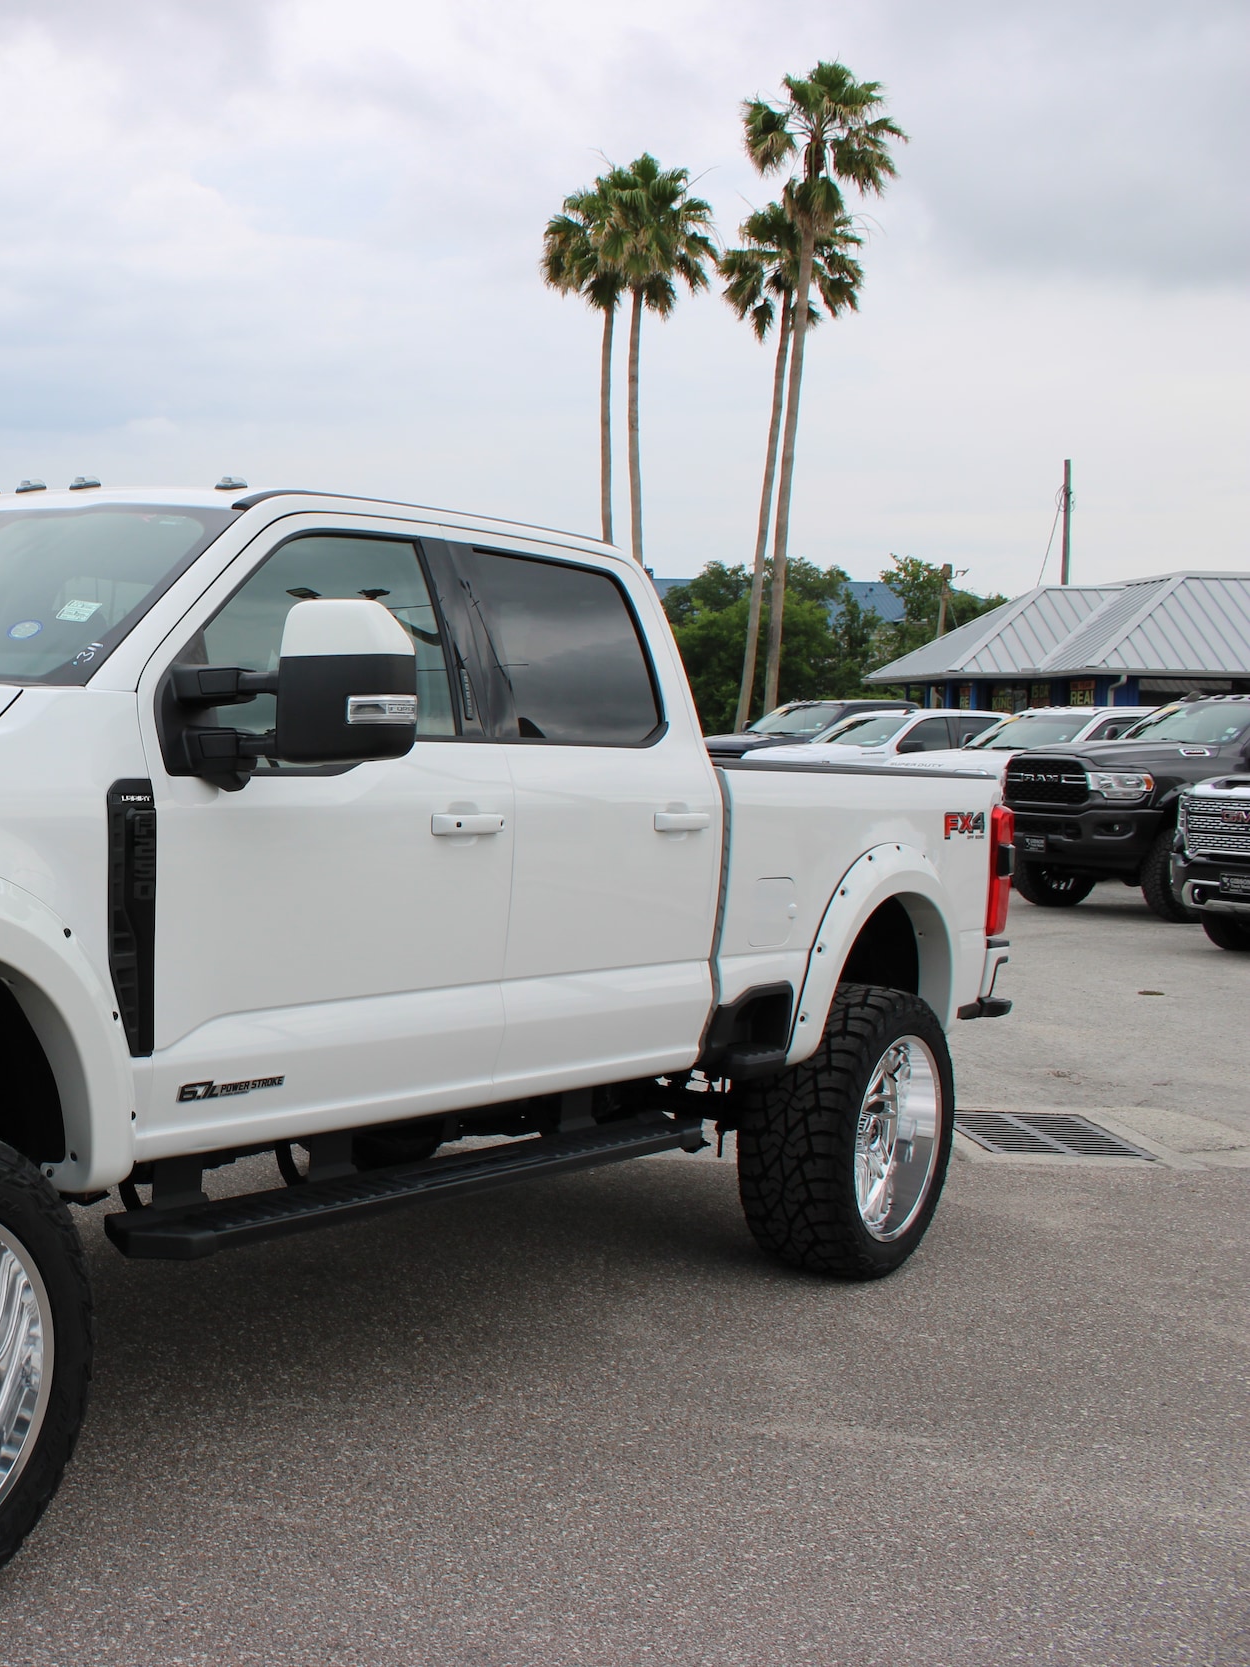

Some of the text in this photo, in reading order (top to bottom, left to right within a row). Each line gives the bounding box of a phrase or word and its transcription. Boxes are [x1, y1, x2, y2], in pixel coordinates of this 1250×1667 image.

[1023, 773, 1059, 782] RAM
[944, 811, 985, 840] FX4
[220, 1082, 249, 1094] POWER
[250, 1076, 284, 1089] STROKE
